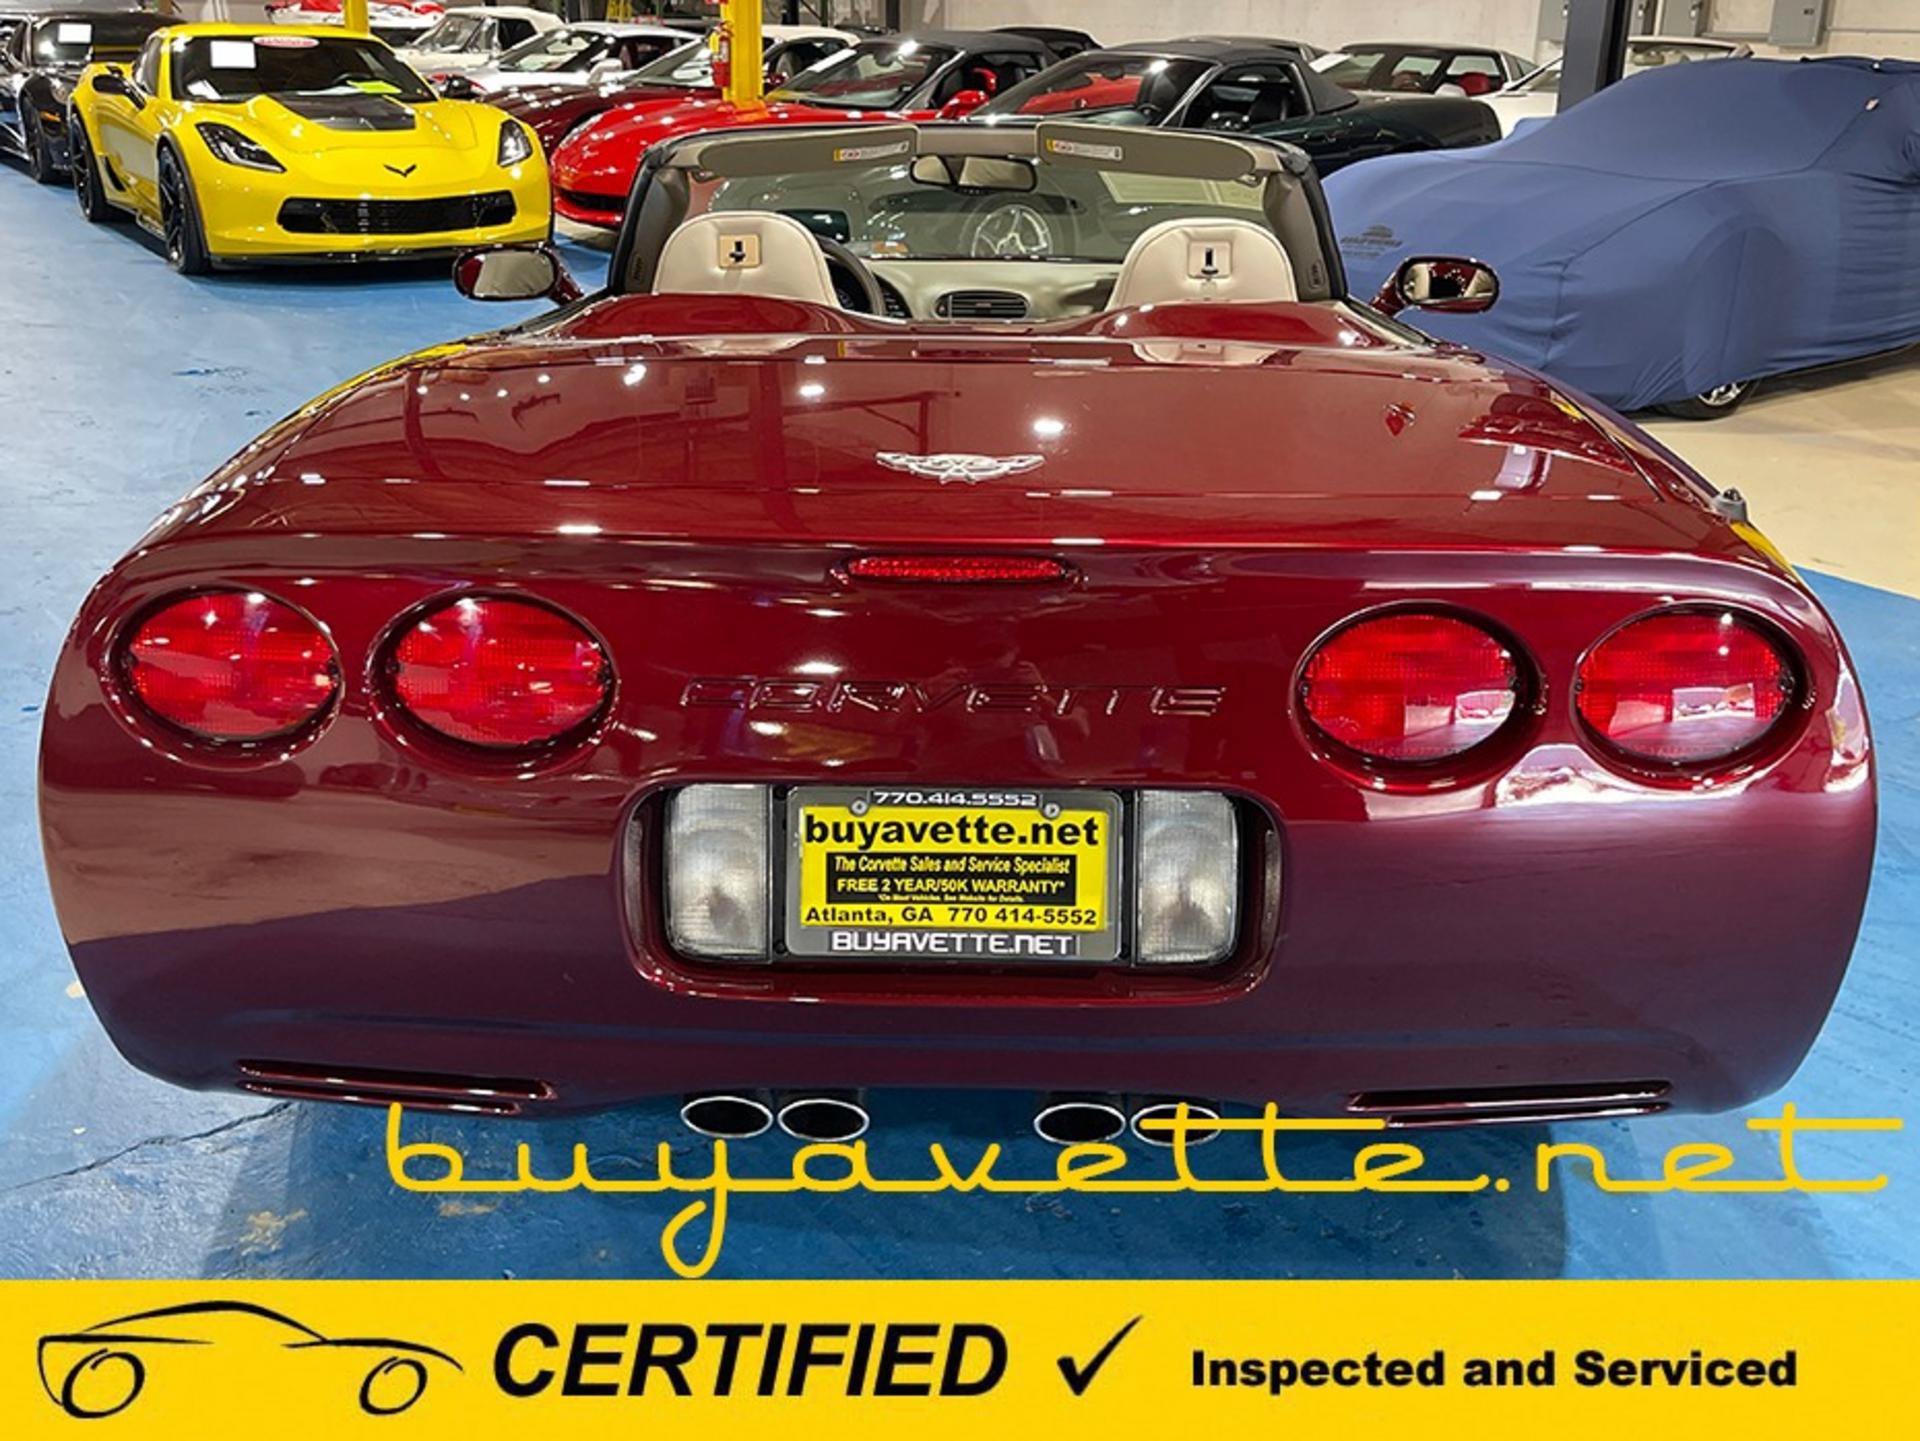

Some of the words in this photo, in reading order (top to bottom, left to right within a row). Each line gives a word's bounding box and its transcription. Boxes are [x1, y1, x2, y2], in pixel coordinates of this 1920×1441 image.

[679, 677, 1227, 718] CORVETTE
[873, 791, 1037, 807] 770.414.5552
[805, 814, 1099, 850] buyavette.net
[834, 856, 856, 871] The
[858, 856, 908, 871] Corvette
[909, 856, 942, 872] Sales
[943, 857, 967, 872] and
[968, 857, 1011, 873] Service
[1013, 857, 1070, 875] Specialist
[836, 878, 878, 892] FREE
[881, 878, 891, 892] 2
[893, 878, 968, 893] YEAR/50K
[805, 907, 893, 924] Atlanta,
[901, 907, 933, 922] GA
[948, 907, 988, 922] 770
[995, 908, 1097, 925] 414-5552
